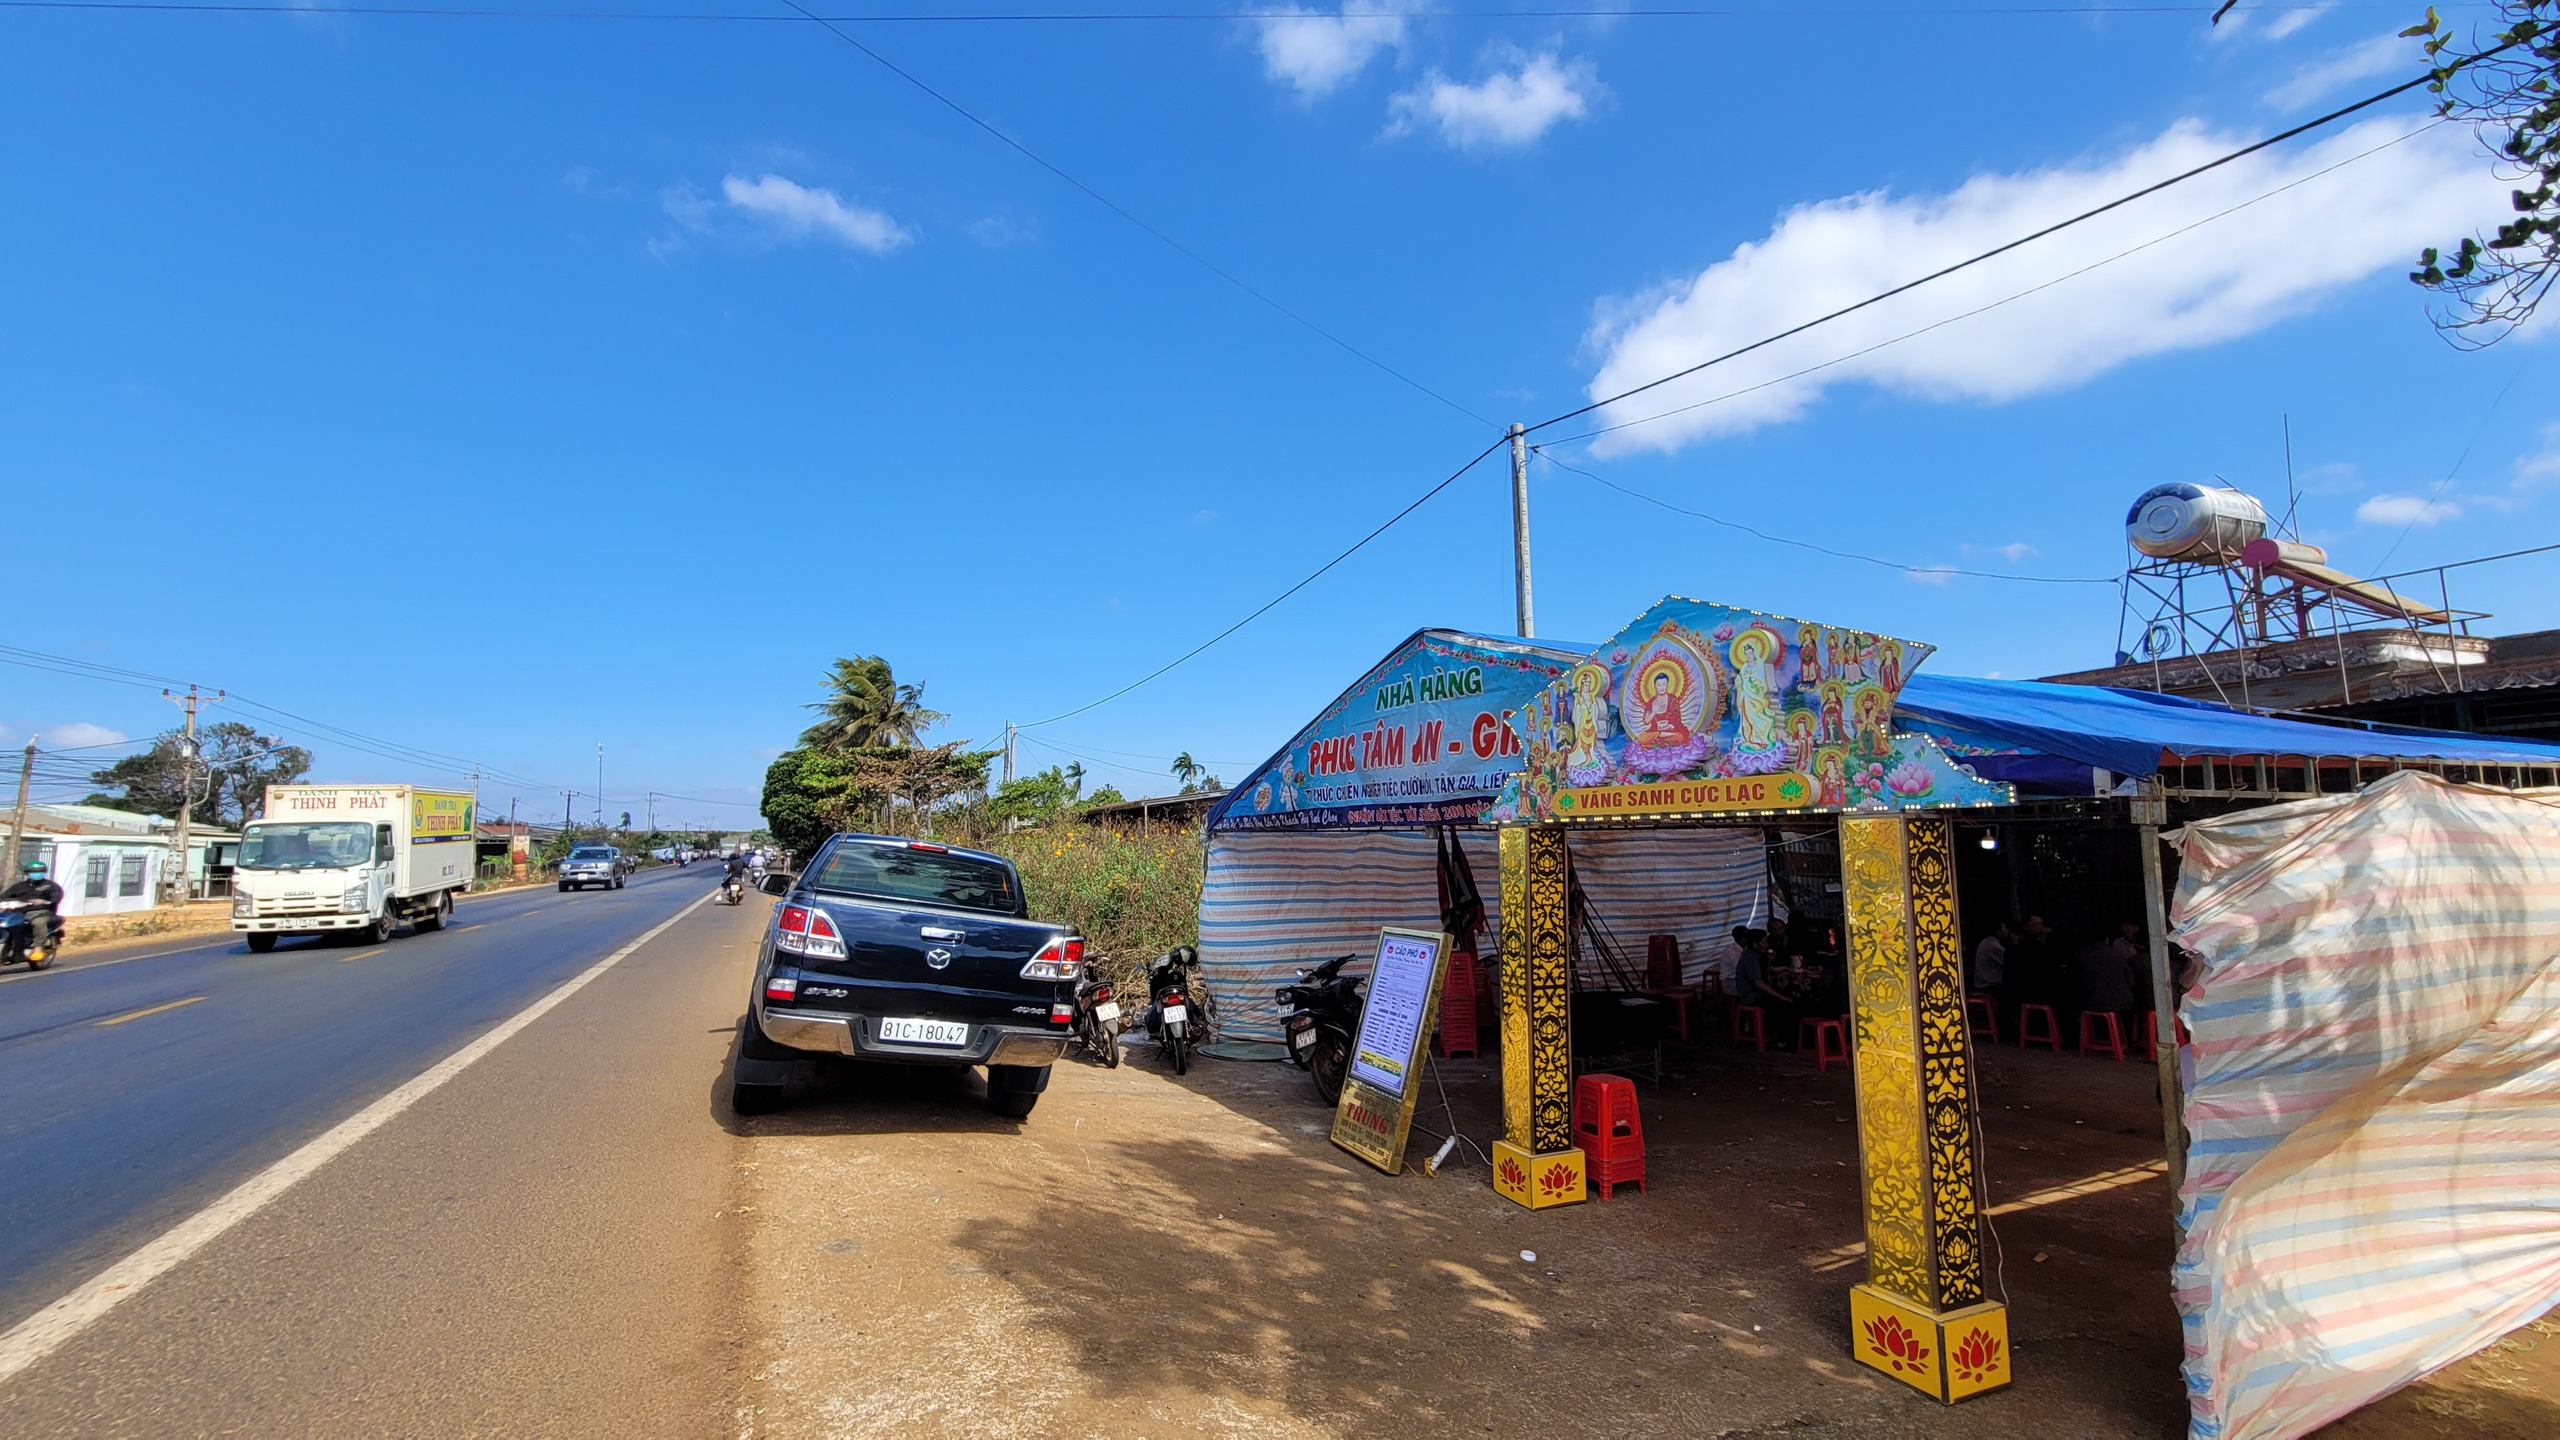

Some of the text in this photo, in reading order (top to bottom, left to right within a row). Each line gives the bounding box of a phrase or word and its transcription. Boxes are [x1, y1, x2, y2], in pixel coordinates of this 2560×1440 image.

[1376, 666, 1483, 711] NHÀ HÀNG
[1362, 719, 1405, 769] TÂM
[290, 794, 388, 811] THỊNH PHÁT
[1580, 783, 1766, 809] VÃNG SANH CỰC LẠC
[882, 1022, 965, 1043] 81C-180.47
